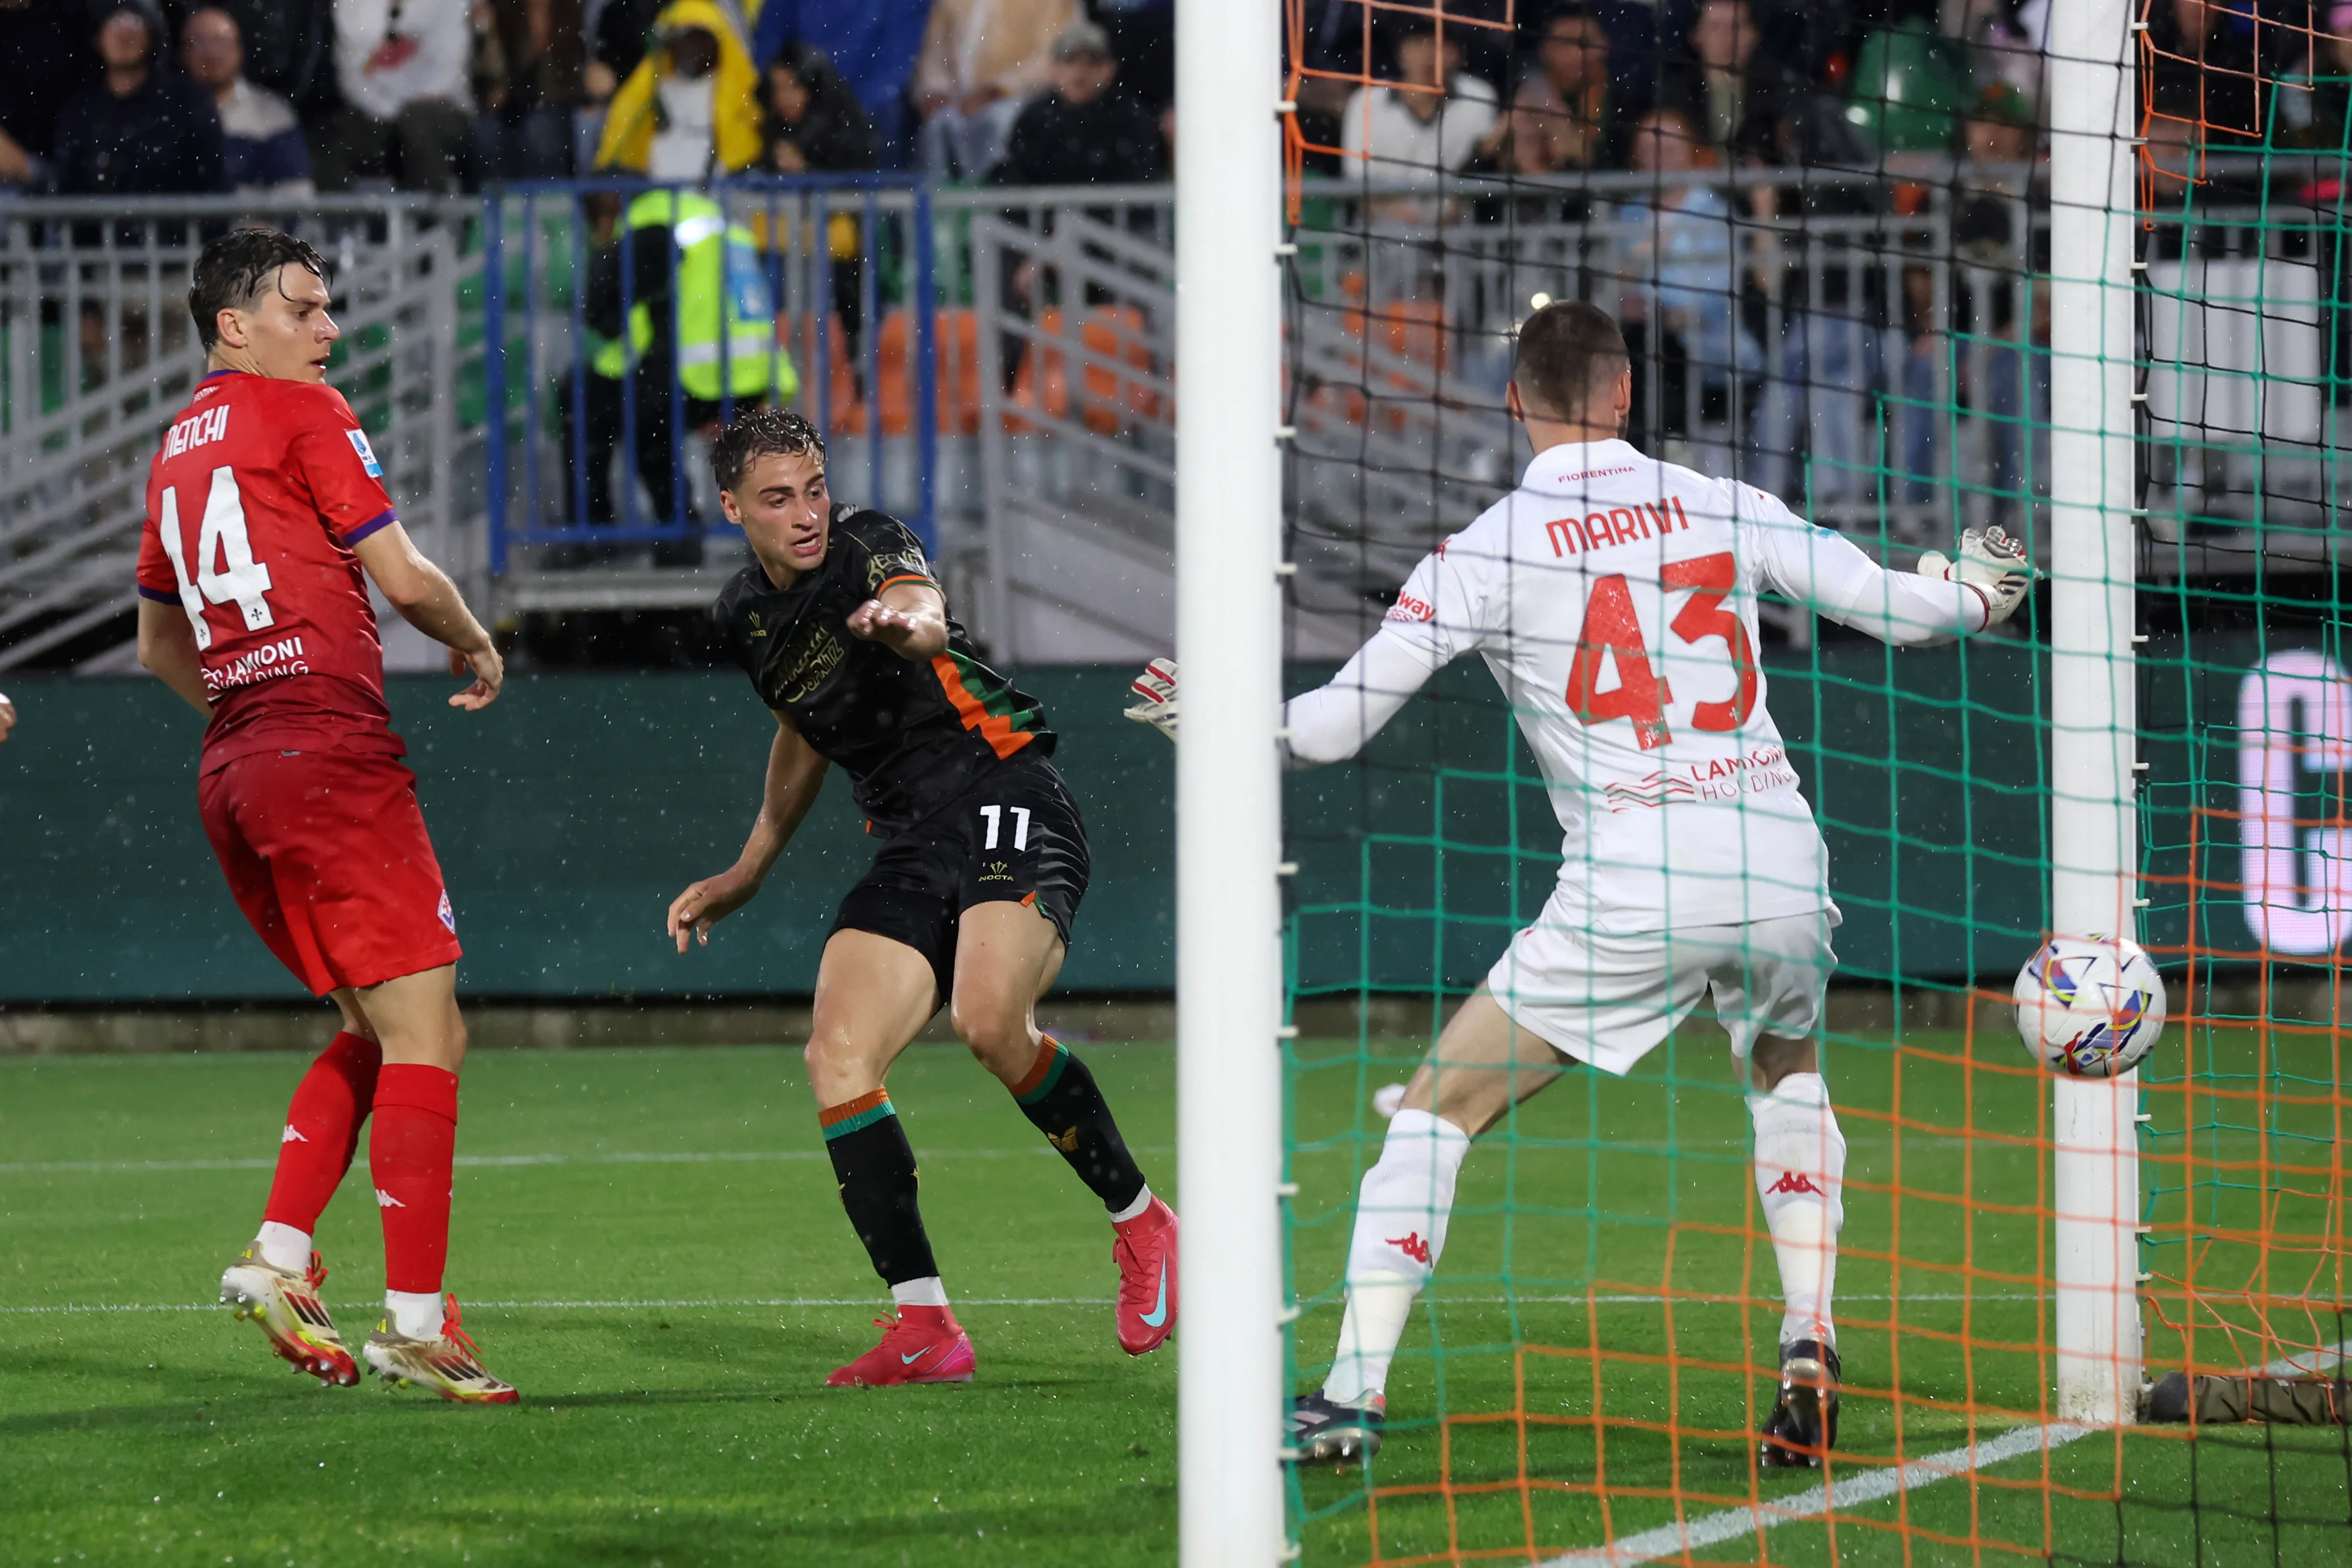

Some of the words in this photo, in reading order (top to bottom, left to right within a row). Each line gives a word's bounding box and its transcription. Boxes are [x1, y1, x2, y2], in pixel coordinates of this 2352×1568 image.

[1558, 466, 1636, 483] FIORENTINA
[1546, 496, 1689, 557] MARIVI
[160, 465, 273, 651] 14
[1399, 590, 1437, 622] way
[227, 637, 303, 680] LAMIONI
[1566, 551, 1757, 751] 43
[980, 805, 1030, 851] 11
